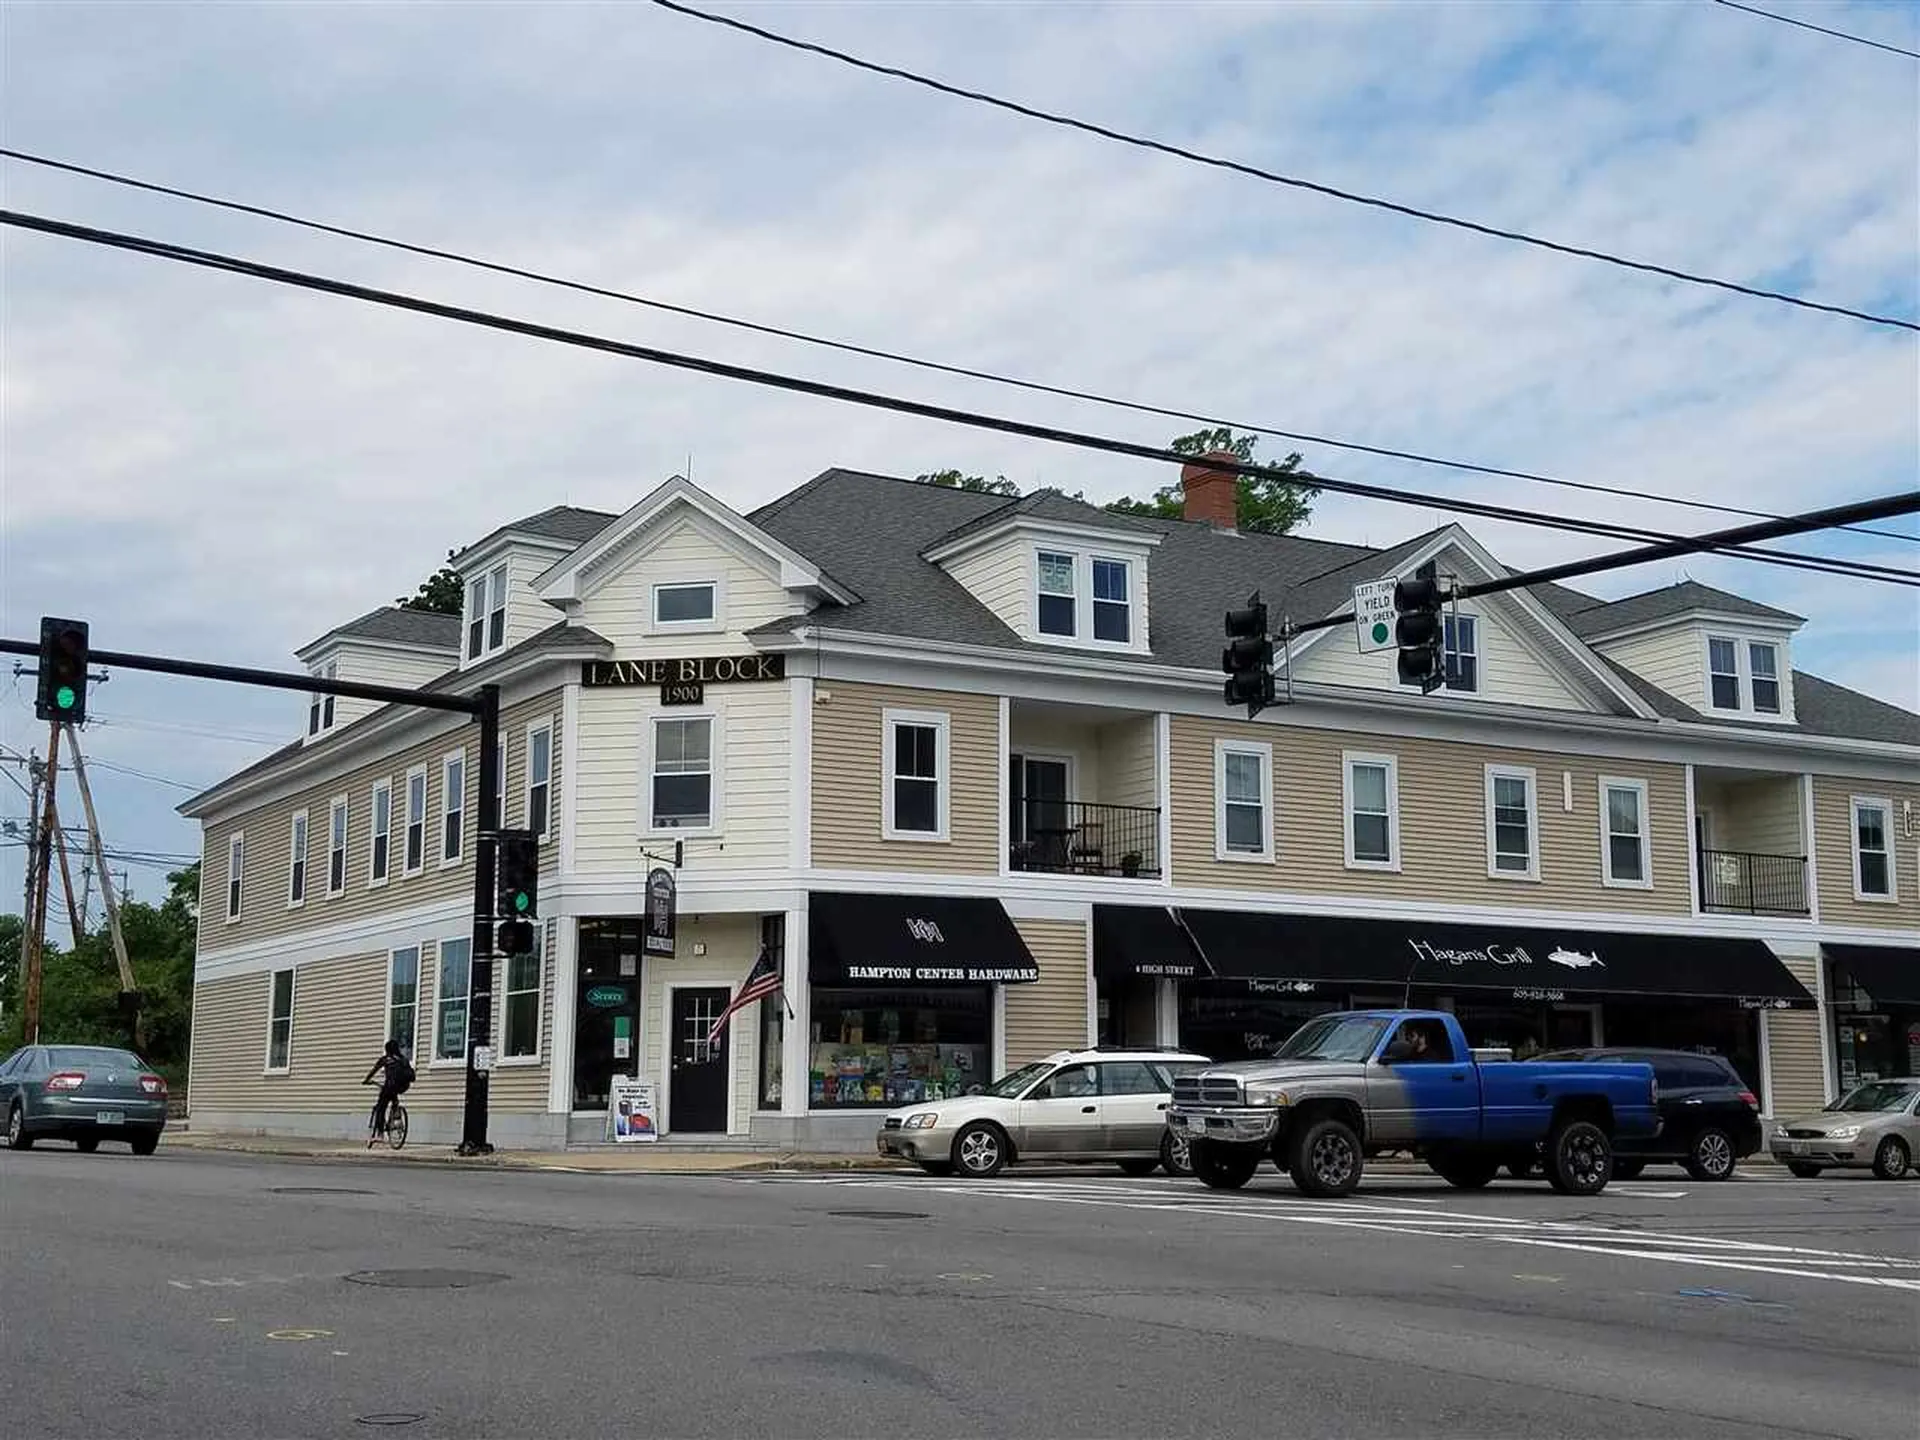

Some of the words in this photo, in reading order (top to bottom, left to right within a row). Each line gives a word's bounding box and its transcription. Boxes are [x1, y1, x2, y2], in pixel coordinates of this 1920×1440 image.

[1357, 586, 1372, 596] LEFT
[1378, 582, 1397, 592] TURN
[1365, 596, 1389, 610] YIELD
[1359, 616, 1369, 625] ON
[1373, 611, 1396, 622] GREEN
[591, 660, 668, 685] LANE
[679, 655, 776, 682] BLOCK
[664, 685, 700, 702] 1900
[1408, 938, 1488, 966] Hagan's
[1487, 944, 1533, 964] Grill
[849, 966, 912, 980] HAMPTON
[916, 967, 965, 980] CENTER
[968, 967, 1038, 981] HARDWARE
[1165, 964, 1194, 976] STREET
